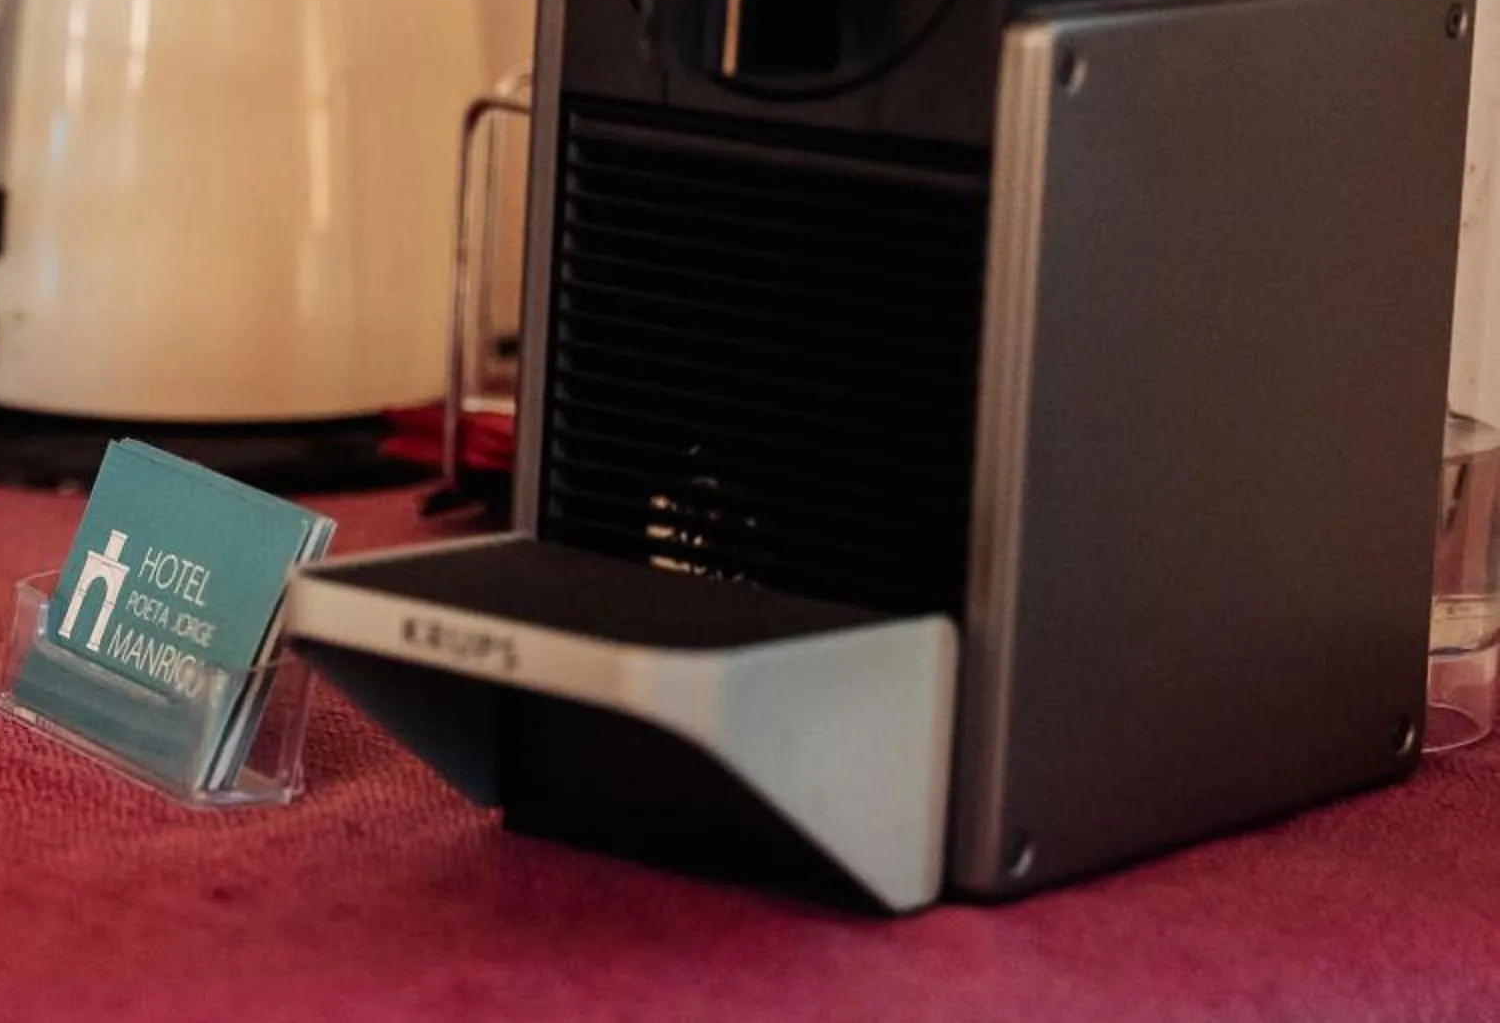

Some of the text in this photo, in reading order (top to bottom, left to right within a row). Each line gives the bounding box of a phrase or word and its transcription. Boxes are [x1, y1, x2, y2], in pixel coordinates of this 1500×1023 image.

[137, 546, 212, 607] HOTEL
[125, 589, 171, 629] POETA
[402, 615, 519, 672] KRUPS
